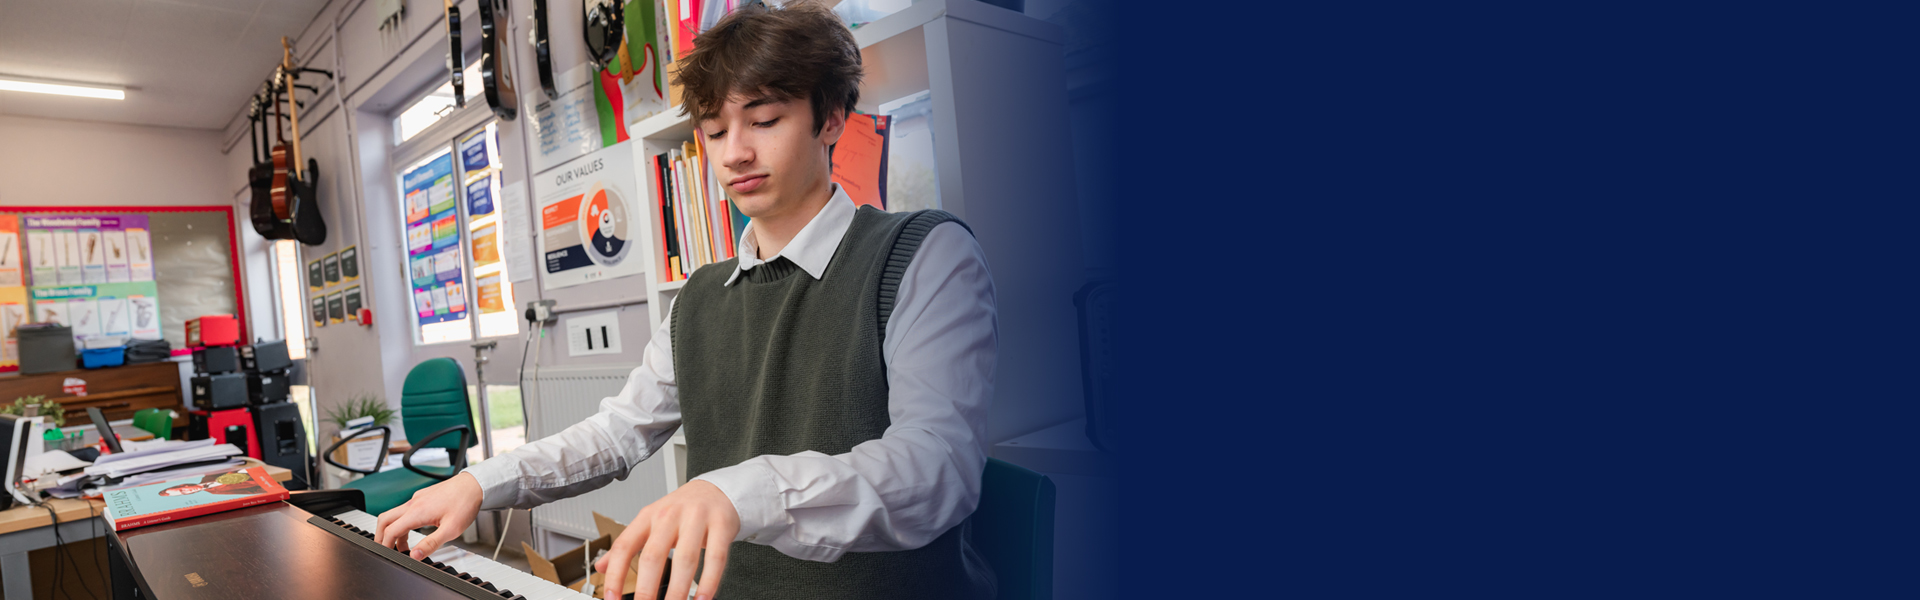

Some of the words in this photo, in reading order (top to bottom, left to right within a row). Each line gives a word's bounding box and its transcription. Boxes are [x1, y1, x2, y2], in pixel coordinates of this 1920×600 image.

[556, 171, 573, 186] OUR
[573, 158, 604, 178] VALUES
[27, 218, 40, 227] The
[42, 217, 76, 227] Woodwind
[77, 217, 101, 228] Family
[34, 289, 47, 297] The
[48, 288, 68, 297] Brass
[69, 287, 92, 297] Family
[110, 491, 137, 517] BRAHMS
[121, 521, 140, 529] BRAHMS
